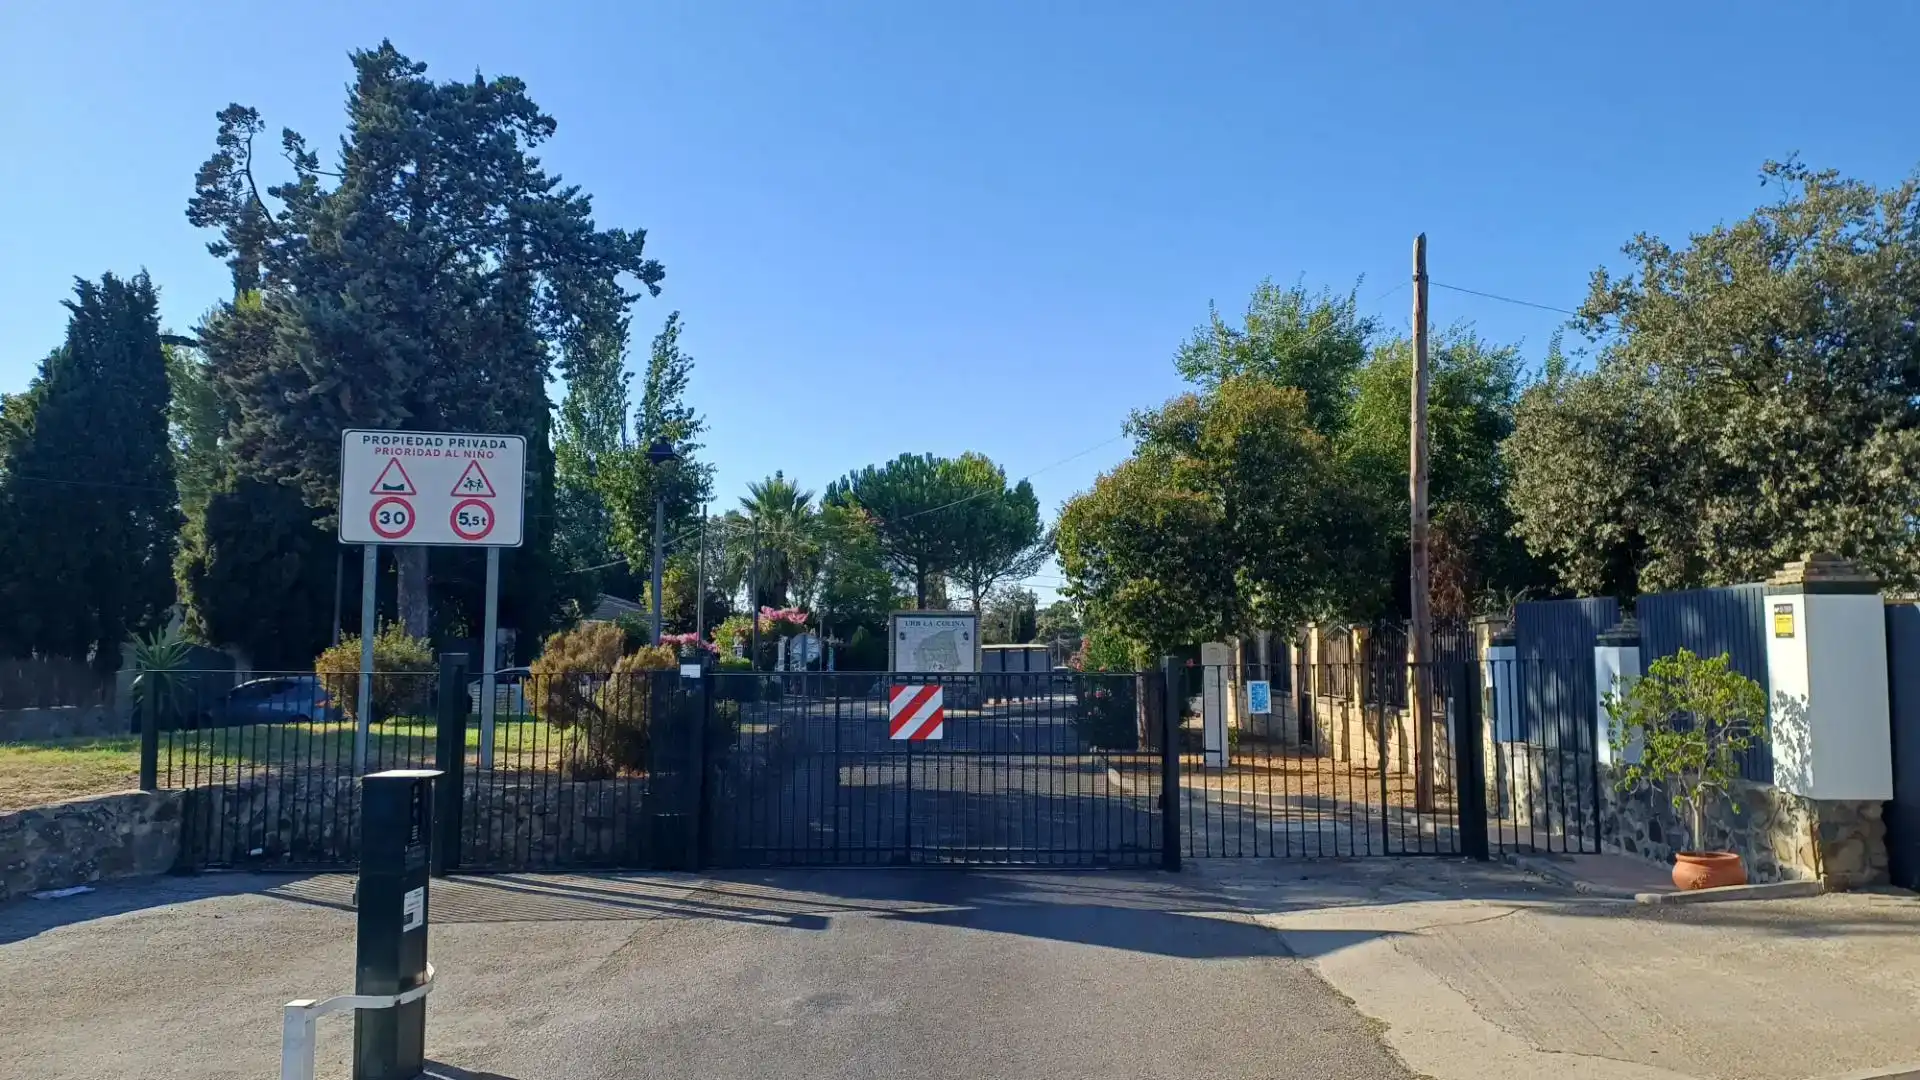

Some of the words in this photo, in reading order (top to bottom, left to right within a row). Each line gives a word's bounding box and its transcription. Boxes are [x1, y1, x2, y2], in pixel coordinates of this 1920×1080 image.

[362, 435, 444, 447] PROPIEDAD
[449, 438, 507, 449] PRIVADA
[374, 447, 441, 457] PRIORIDAD
[444, 450, 459, 458] AL
[463, 449, 495, 459] NIÑO
[378, 511, 406, 525] 30
